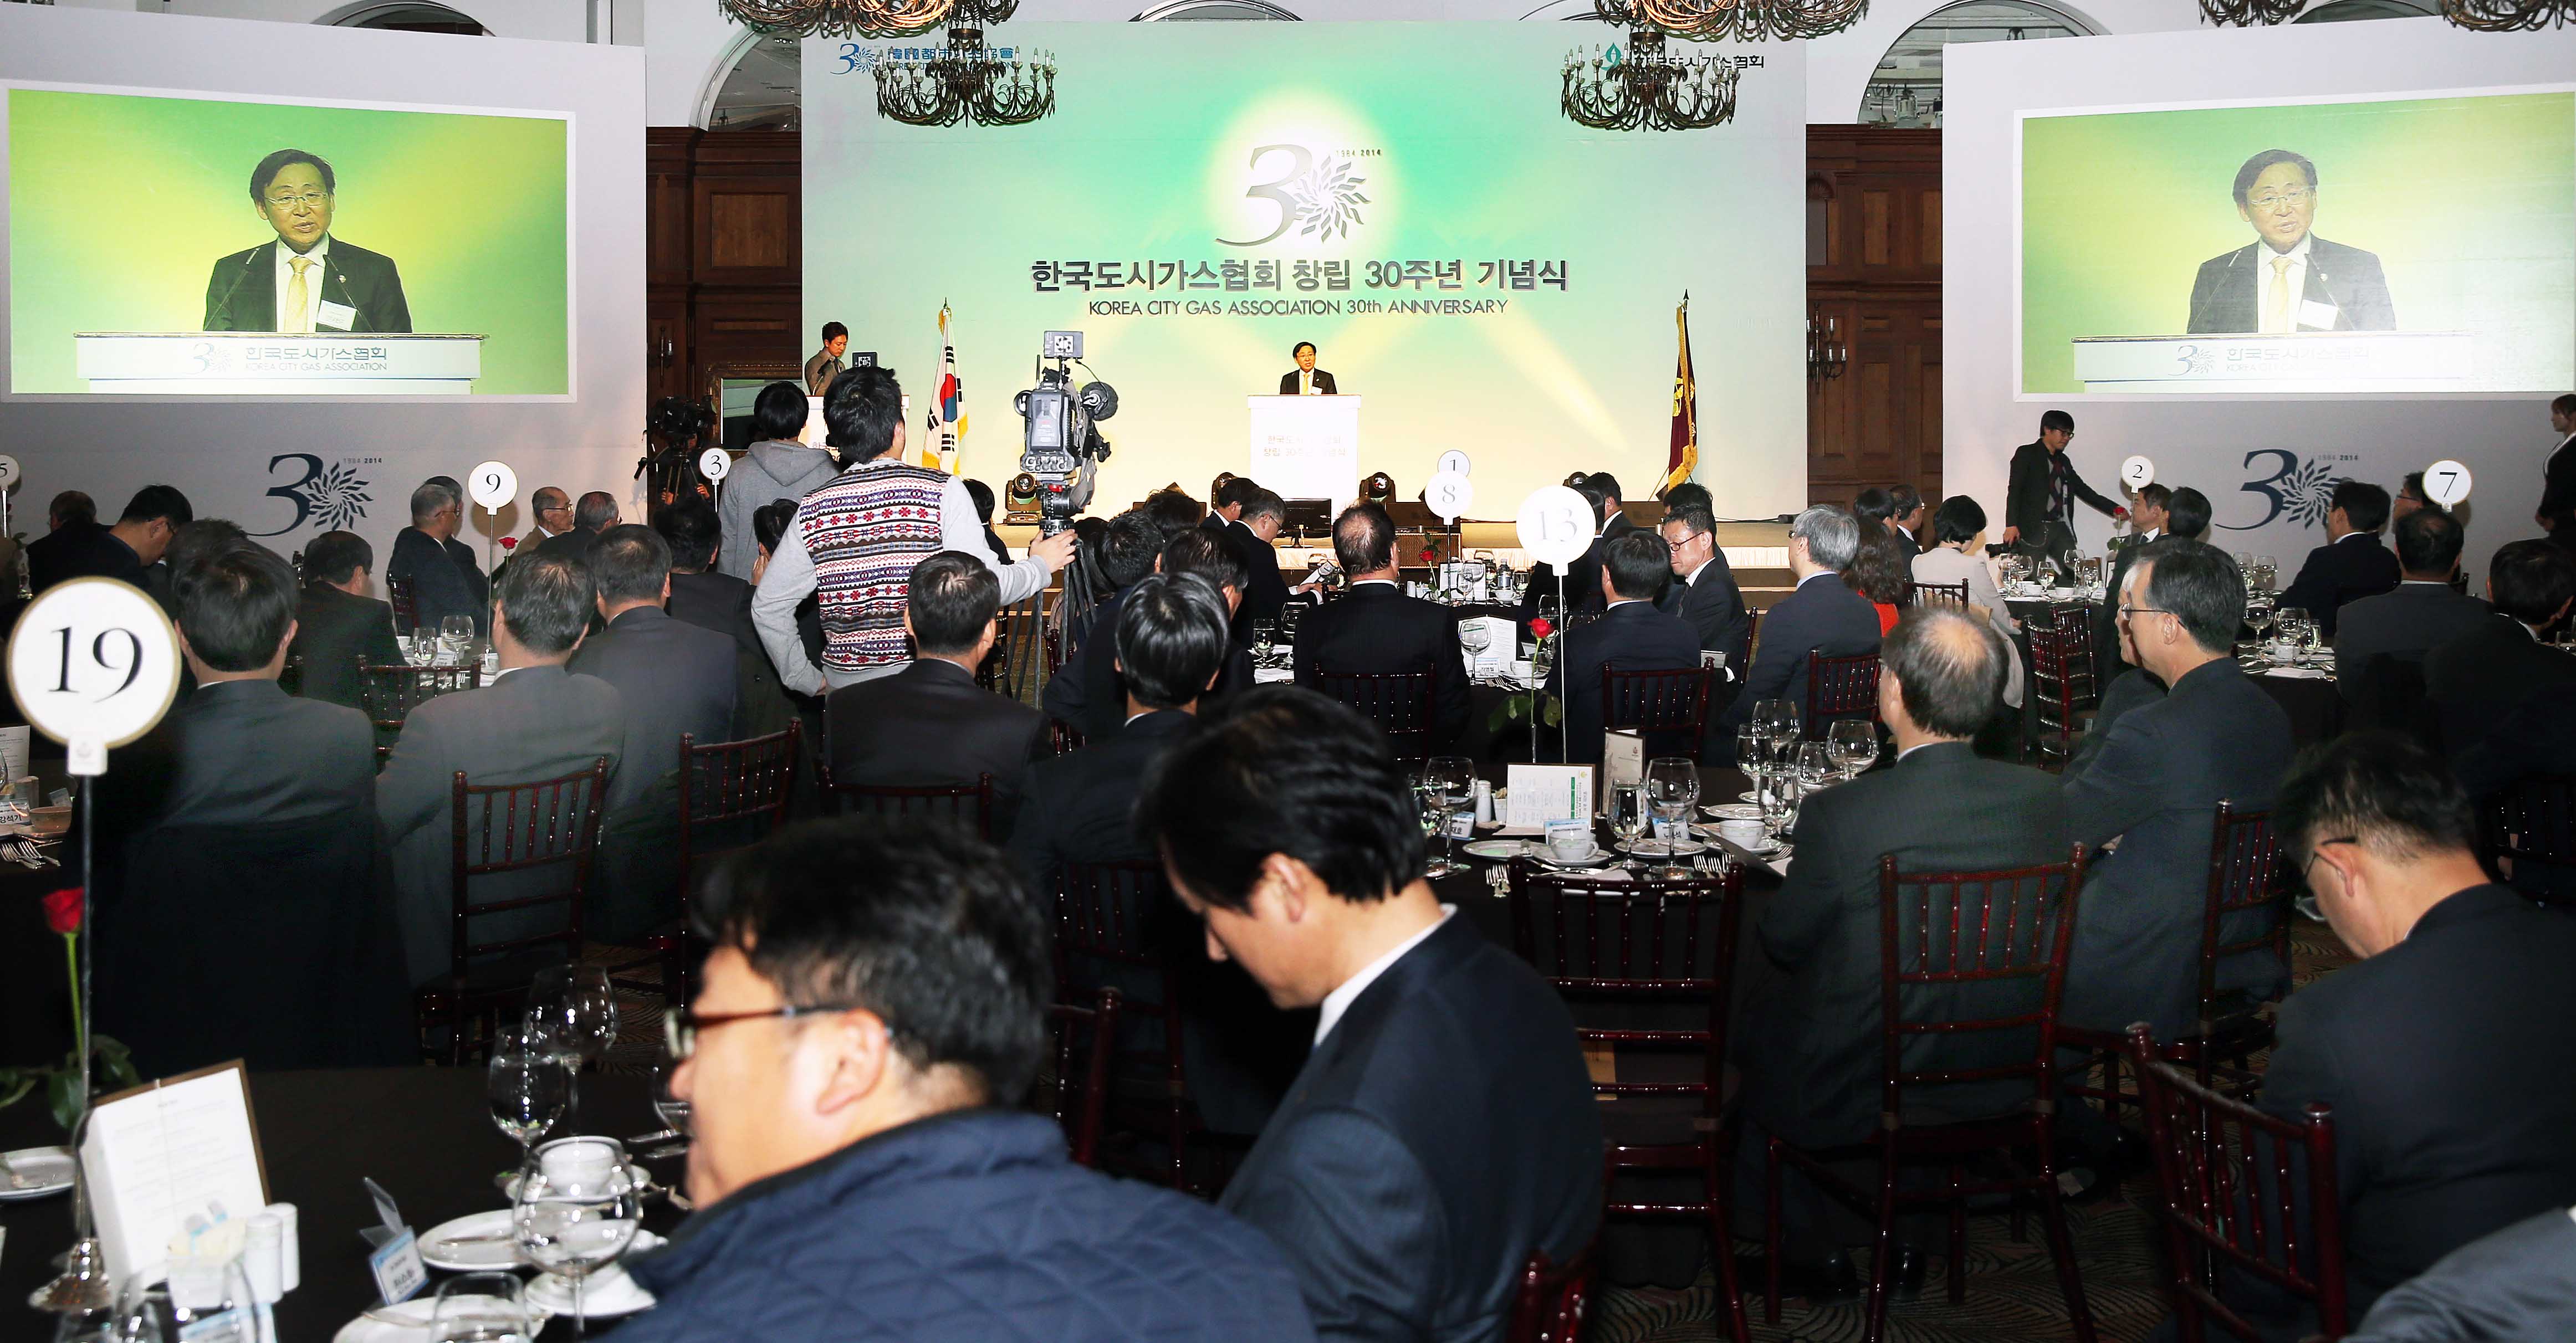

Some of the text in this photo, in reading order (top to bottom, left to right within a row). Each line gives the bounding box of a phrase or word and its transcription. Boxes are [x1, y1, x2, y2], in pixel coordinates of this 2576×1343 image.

[1031, 259, 1567, 292] 한국도시가스협회 창립 30주년 기념식
[1089, 299, 1509, 316] KOREA CITY GAS ASSOCIATION 30th ANNIVERSARY
[246, 347, 387, 360] 한국도시가스협회
[279, 363, 298, 371] CITY
[300, 363, 321, 371] GAS
[325, 362, 387, 371] ASSOCIATION
[711, 455, 722, 475] 3
[1449, 459, 1456, 471] 1
[2133, 464, 2143, 479] 2
[486, 473, 500, 495] 9
[2440, 471, 2457, 498] 7
[1442, 485, 1455, 504] 8
[1539, 508, 1577, 542] 13
[48, 627, 143, 703] 19
